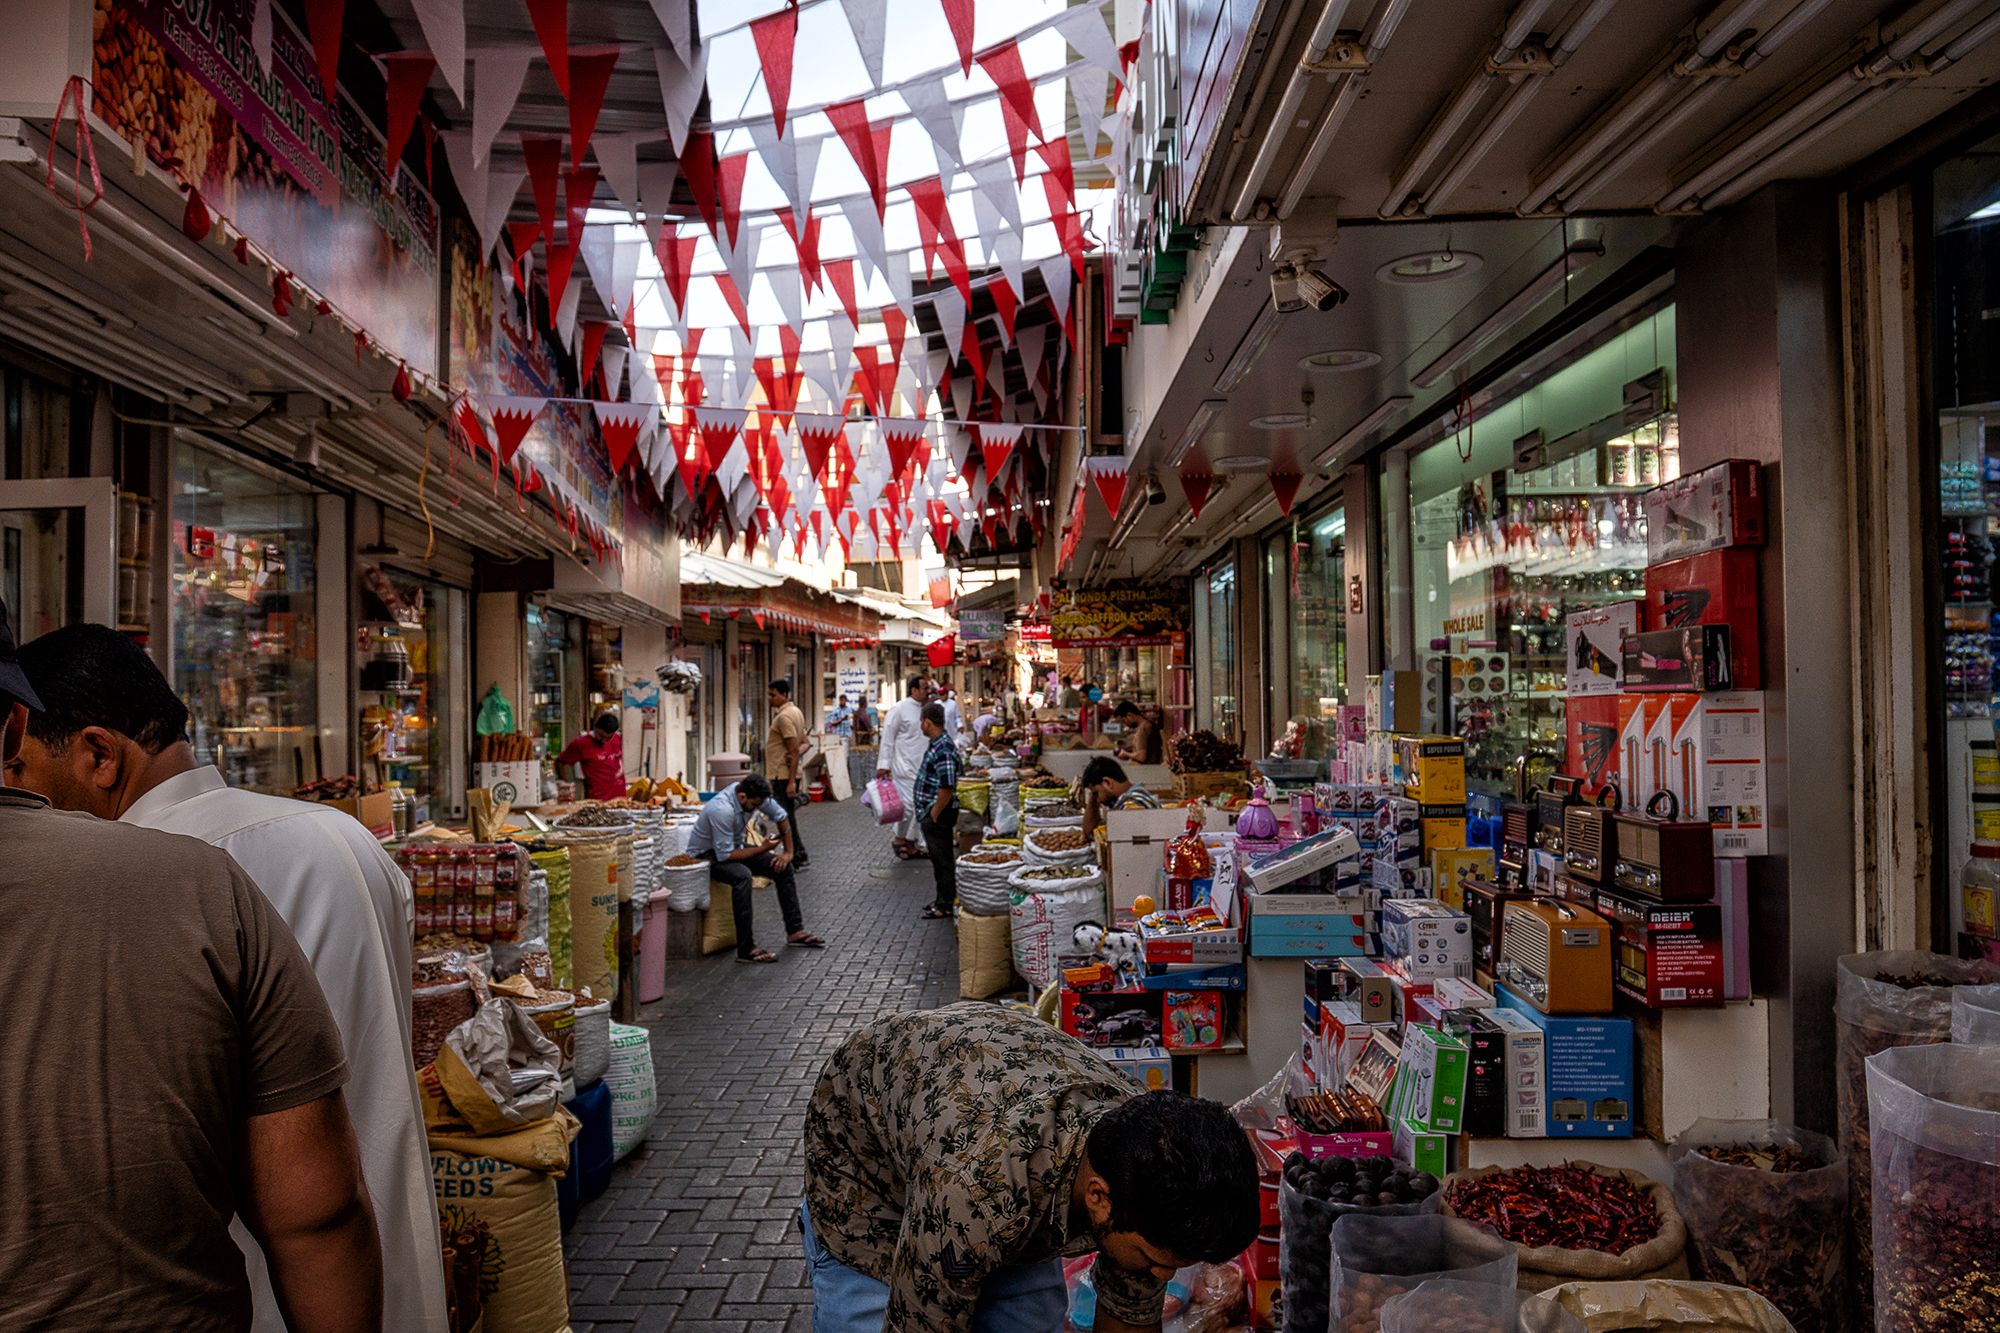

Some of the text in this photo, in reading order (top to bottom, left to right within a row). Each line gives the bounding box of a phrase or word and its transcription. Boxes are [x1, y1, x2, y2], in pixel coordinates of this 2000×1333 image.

[309, 114, 337, 182] FOR
[340, 152, 373, 212] NUTS
[1060, 591, 1108, 606] ALONDS
[1443, 614, 1484, 634] WHOLE SALE
[1427, 744, 1462, 755] SUPER POWER
[1427, 805, 1443, 815] SUPER
[1650, 912, 1690, 922] MEIER
[432, 1155, 521, 1177] FLOWE
[435, 1176, 494, 1199] EEDS
